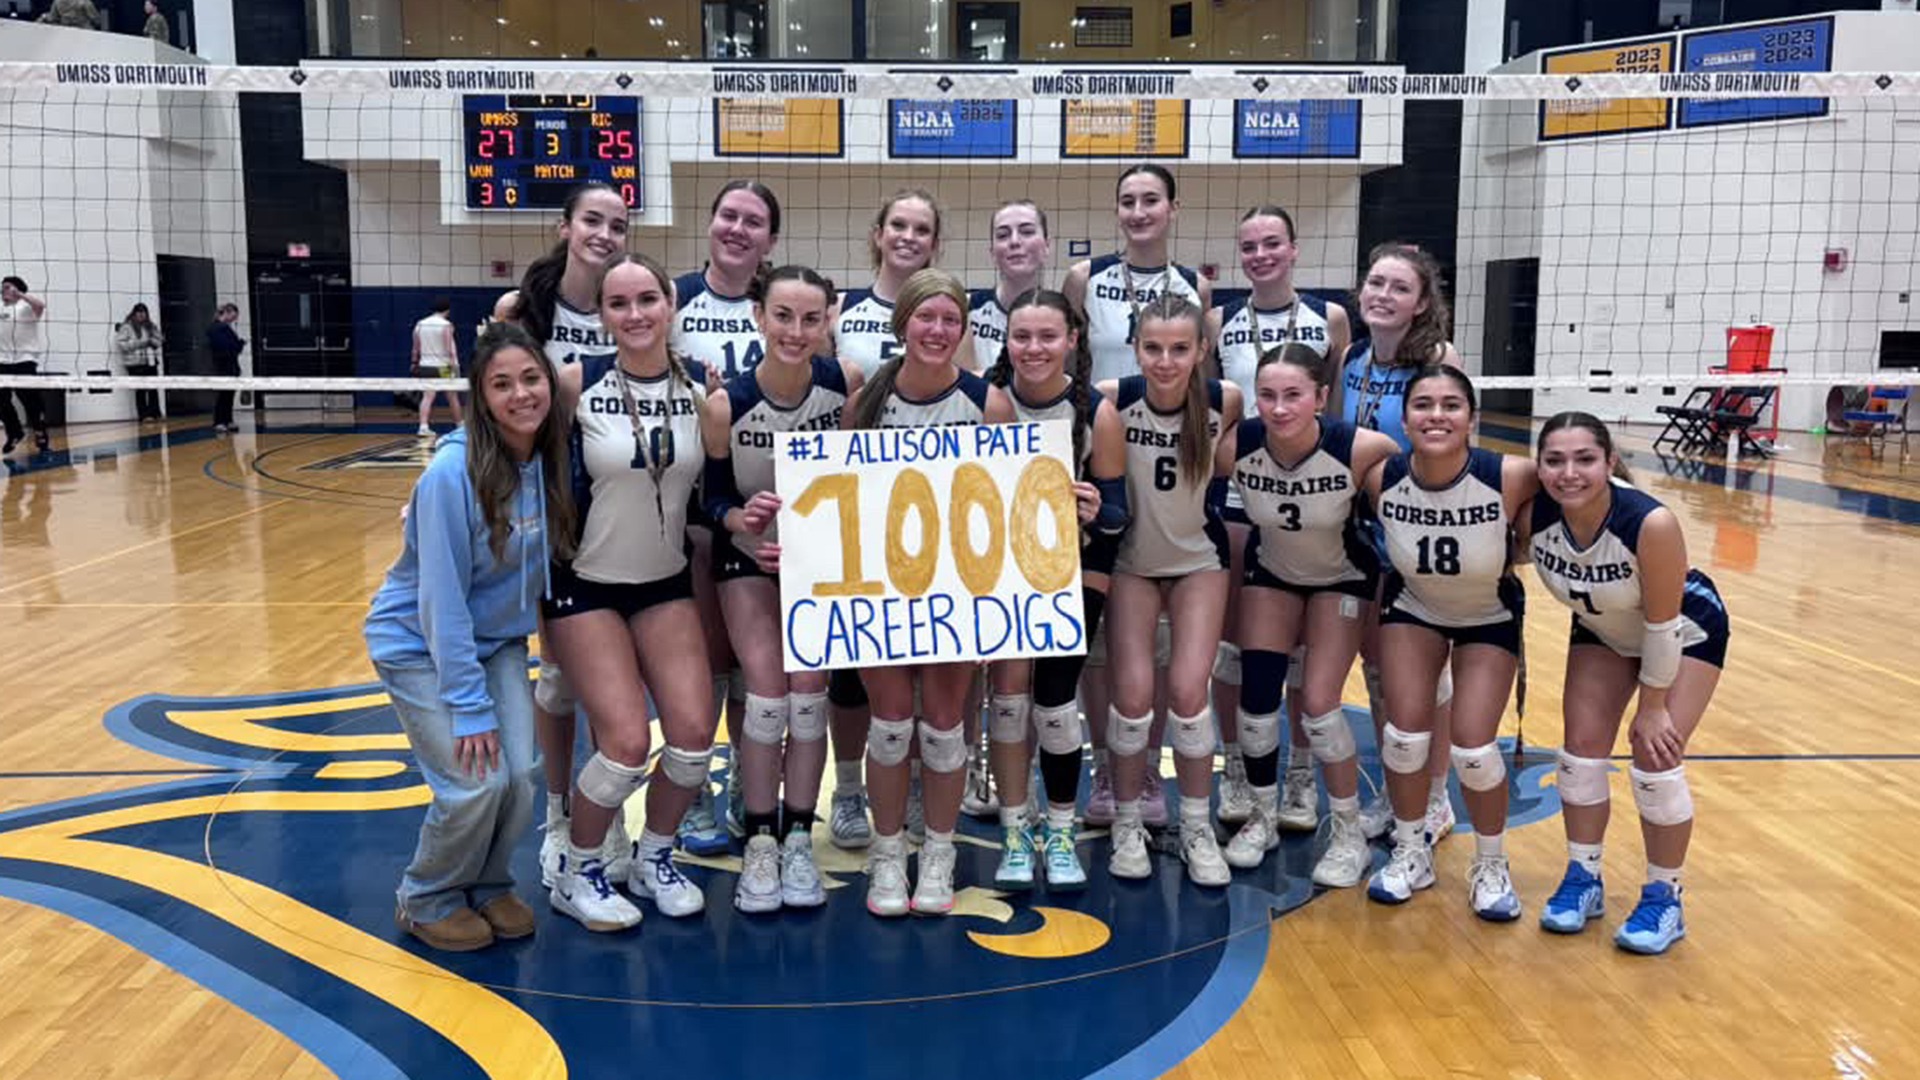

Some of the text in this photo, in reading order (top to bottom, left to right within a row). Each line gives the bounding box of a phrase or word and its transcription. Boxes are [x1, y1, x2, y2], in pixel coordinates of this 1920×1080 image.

[1763, 29, 1815, 48] 2023
[1616, 48, 1661, 65] 2023
[1764, 46, 1813, 63] 2024
[57, 64, 206, 86] UMASS DARTMOUTH
[390, 70, 534, 90] UMASS DARTMOUTH
[714, 74, 857, 93] UMASS DARTMOUTH
[1033, 76, 1174, 95] UMASS DARTMOUTH
[1348, 76, 1487, 94] UMASS DARTMOUTH
[1660, 74, 1800, 92] UMASS DARTMOUTH
[480, 113, 519, 126] UMASS
[591, 113, 612, 127] RIC
[898, 111, 954, 128] NCAA
[1245, 112, 1299, 128] NCAA
[478, 130, 514, 158] 27
[547, 133, 559, 155] 3
[598, 130, 634, 158] 25
[469, 165, 494, 177] WON
[534, 165, 574, 178] MATCH
[611, 165, 635, 179] WON
[481, 182, 493, 205] 3
[621, 183, 634, 206] 0
[721, 340, 764, 379] 14
[630, 426, 675, 469] 10
[788, 424, 1042, 465] #1 ALLISON PATE
[1155, 456, 1177, 491] 6
[1237, 470, 1348, 496] CORSAIRS
[1278, 503, 1302, 531] 3
[1383, 501, 1500, 526] CORSAIRS
[791, 455, 1081, 597] 1000
[1416, 535, 1461, 575] 18
[1535, 546, 1633, 583] CORSAIRS
[1569, 589, 1602, 615] 7
[787, 592, 1083, 668] CAREER DIGS
